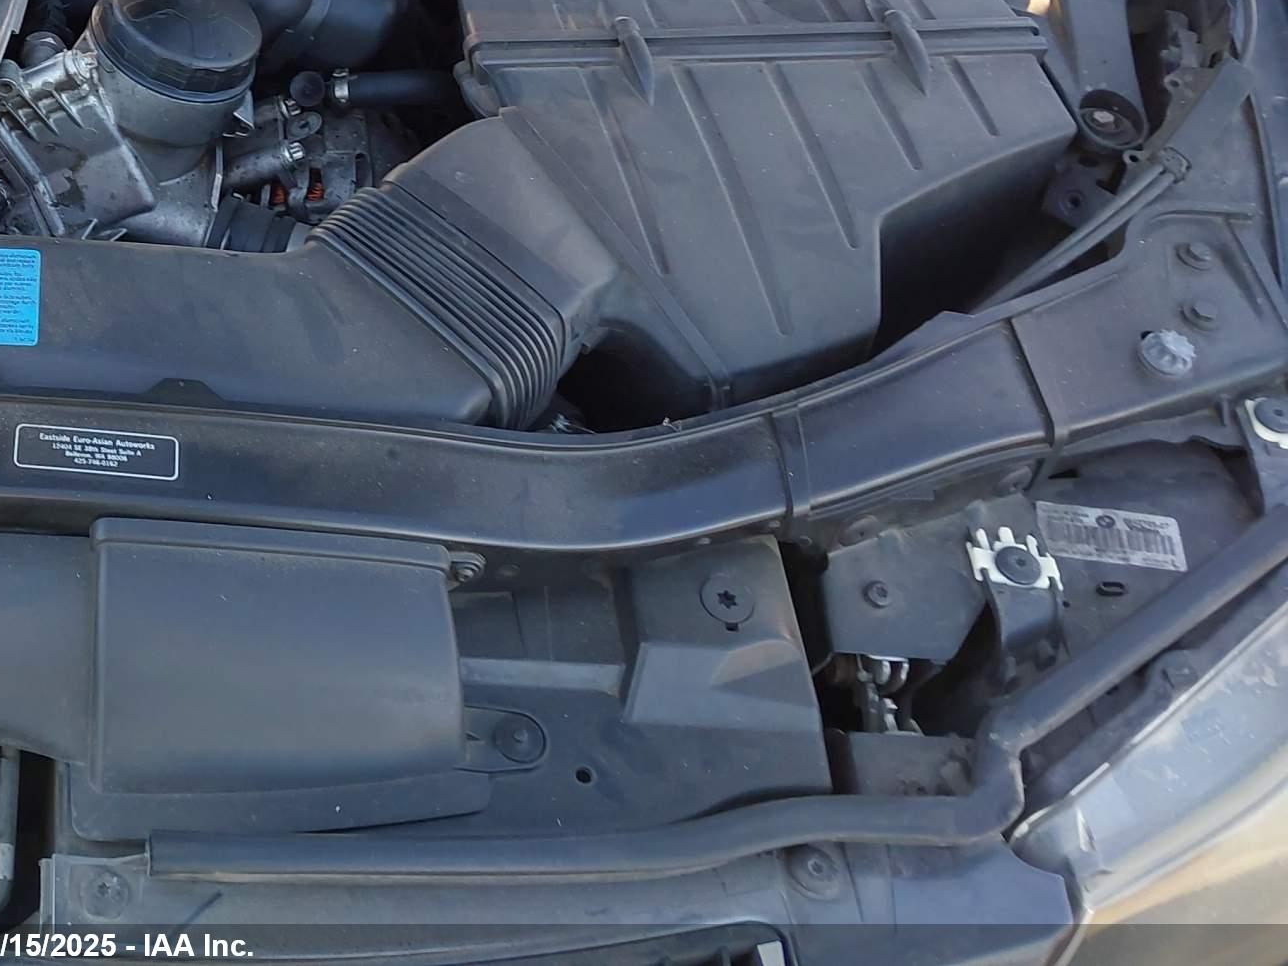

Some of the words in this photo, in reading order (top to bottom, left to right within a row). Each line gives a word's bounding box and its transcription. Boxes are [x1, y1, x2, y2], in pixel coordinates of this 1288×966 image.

[39, 433, 71, 443] Eastside
[73, 435, 114, 447] Euro-Asian
[116, 439, 156, 451] Autoworks
[136, 449, 143, 457] A
